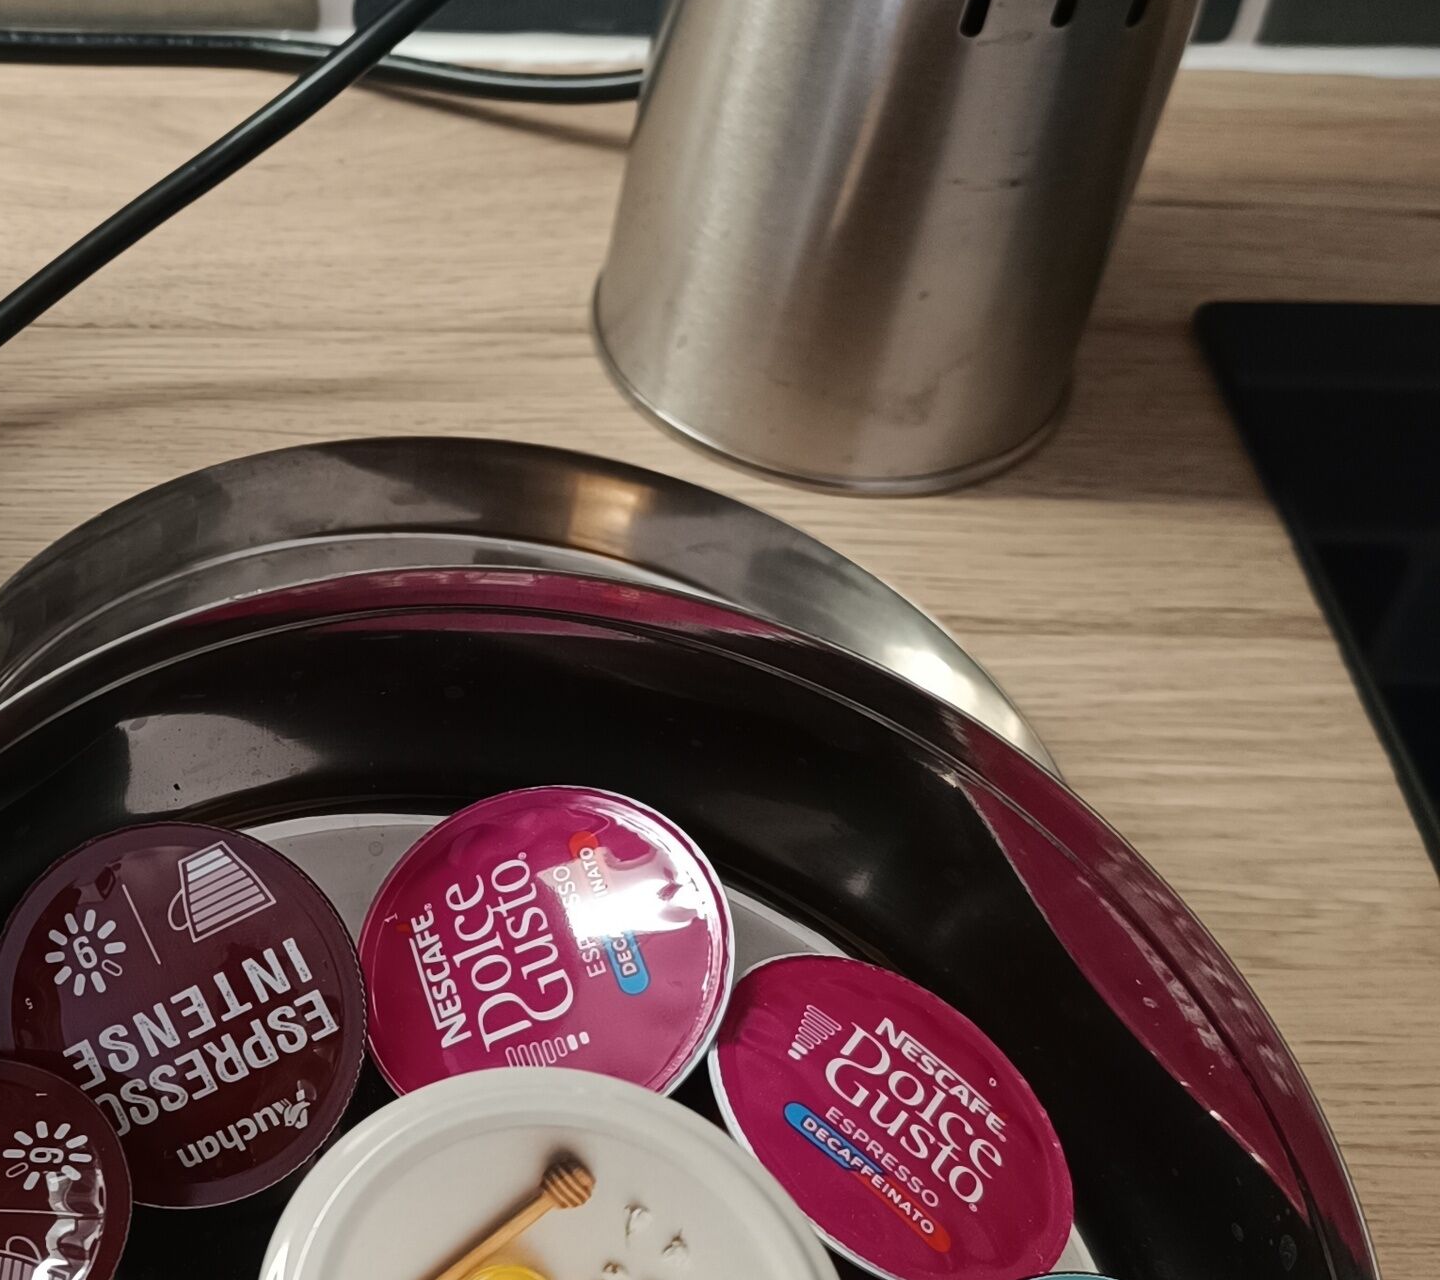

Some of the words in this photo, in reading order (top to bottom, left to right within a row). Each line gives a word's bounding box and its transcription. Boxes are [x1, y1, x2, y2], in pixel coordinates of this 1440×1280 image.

[73, 935, 98, 969] 9
[445, 873, 533, 1052] Dolce
[491, 858, 575, 1021] Gusto
[553, 865, 607, 978] ESPSSO
[579, 847, 638, 977] DECINATO
[63, 937, 313, 1091] INTENSE
[176, 1086, 311, 1168] Auchan
[824, 1106, 940, 1208] ESPRESSO
[825, 1057, 985, 1205] Gusto
[840, 1022, 1003, 1179] Dolce
[802, 1117, 935, 1235] DECAFFEINATO
